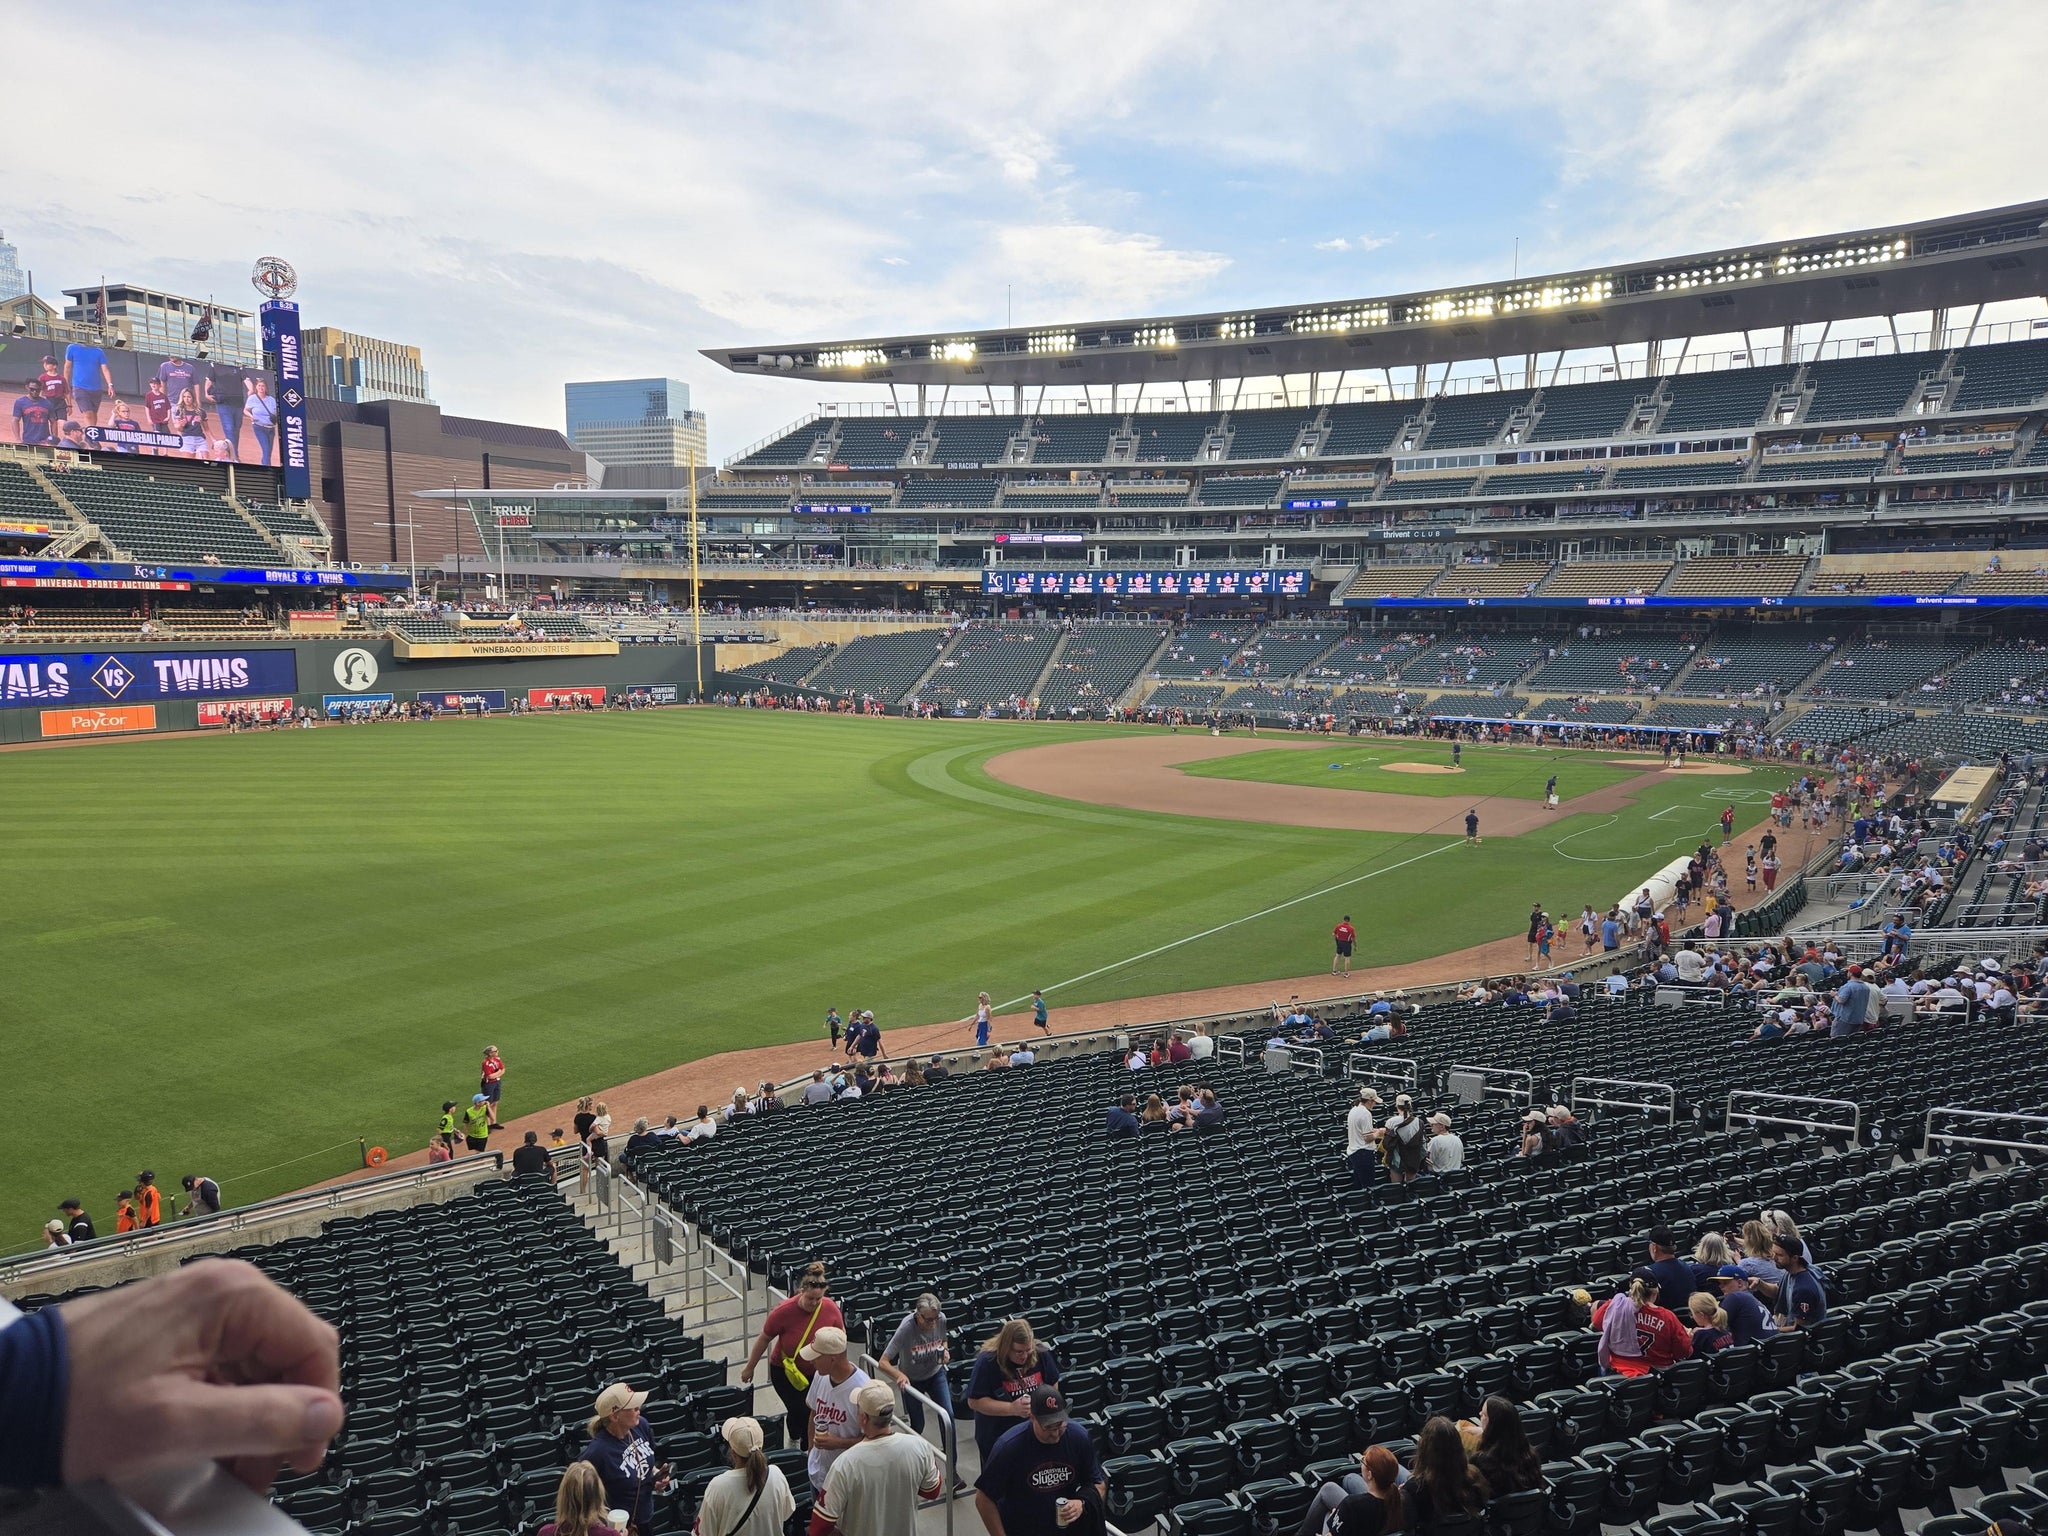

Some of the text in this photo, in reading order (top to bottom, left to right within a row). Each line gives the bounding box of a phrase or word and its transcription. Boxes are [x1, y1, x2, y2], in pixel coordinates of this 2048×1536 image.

[281, 334, 299, 380] TWINS
[286, 415, 304, 468] ROYALS
[947, 462, 979, 470] END RACISM
[493, 505, 533, 516] TRULY
[1383, 530, 1410, 538] thrivent
[18, 565, 37, 573] NIGHT
[265, 570, 298, 583] ROYALS
[317, 572, 344, 584] TWINS
[35, 578, 161, 590] UNIVERSAL SPORTS AUCTIONS
[1625, 597, 1646, 605] TWINS
[613, 635, 677, 643] Corona Corona Corona
[722, 635, 740, 643] Corona
[747, 635, 764, 643] Corona
[472, 645, 570, 654] WINNEBAGO INDUSTRIES
[0, 657, 249, 699] ALS VS TWINS
[71, 715, 128, 730] Paycor
[1635, 1313, 1665, 1331] AUER
[1636, 1329, 1655, 1357] 7
[815, 1398, 847, 1425] Twins
[1032, 1471, 1072, 1486] Slugger
